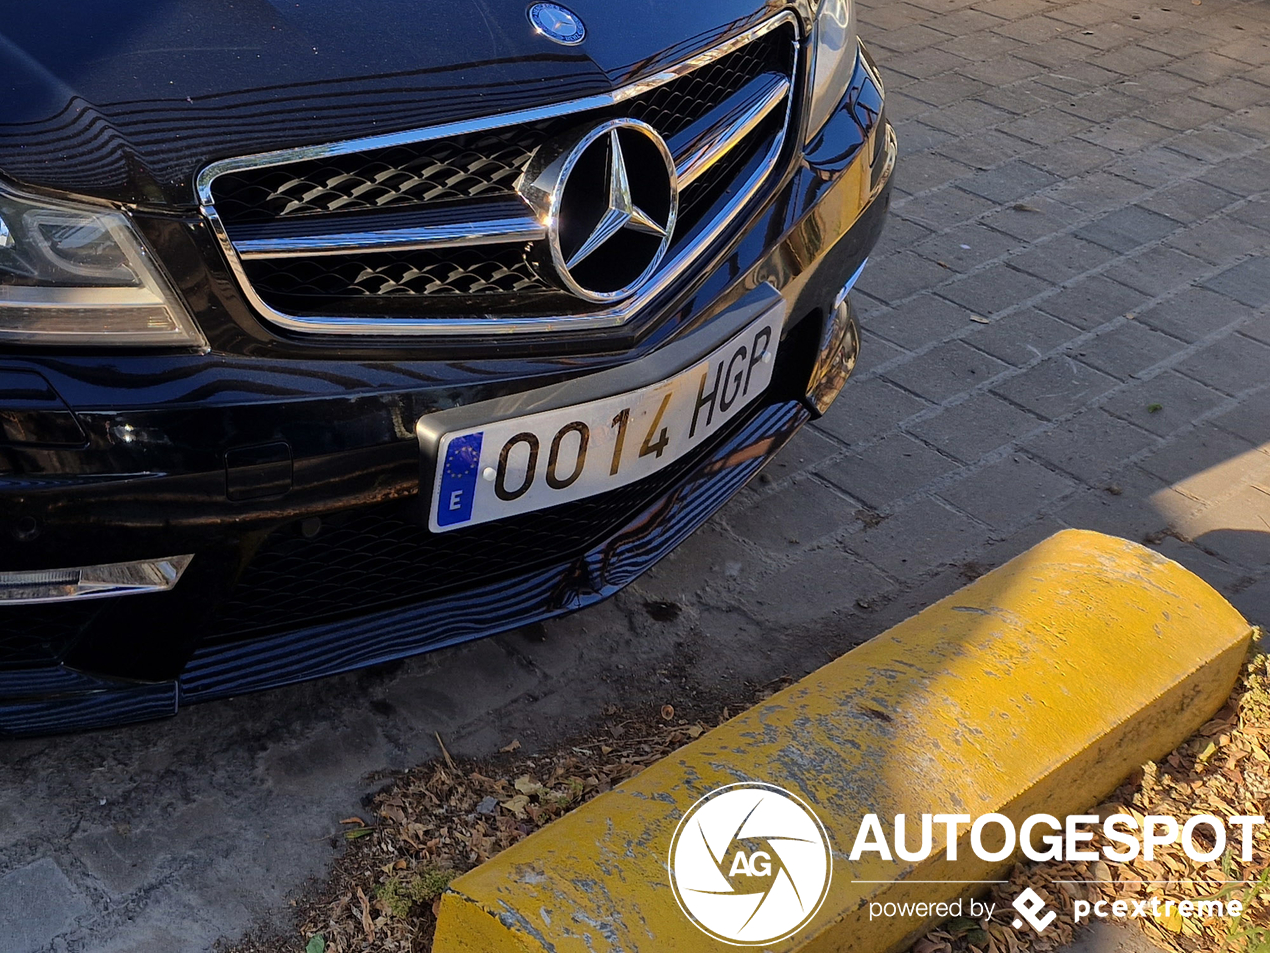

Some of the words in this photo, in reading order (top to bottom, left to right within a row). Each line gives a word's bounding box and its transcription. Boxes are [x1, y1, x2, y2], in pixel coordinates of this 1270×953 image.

[494, 392, 673, 502] 0014
[689, 326, 772, 440] HGP
[449, 490, 463, 510] E
